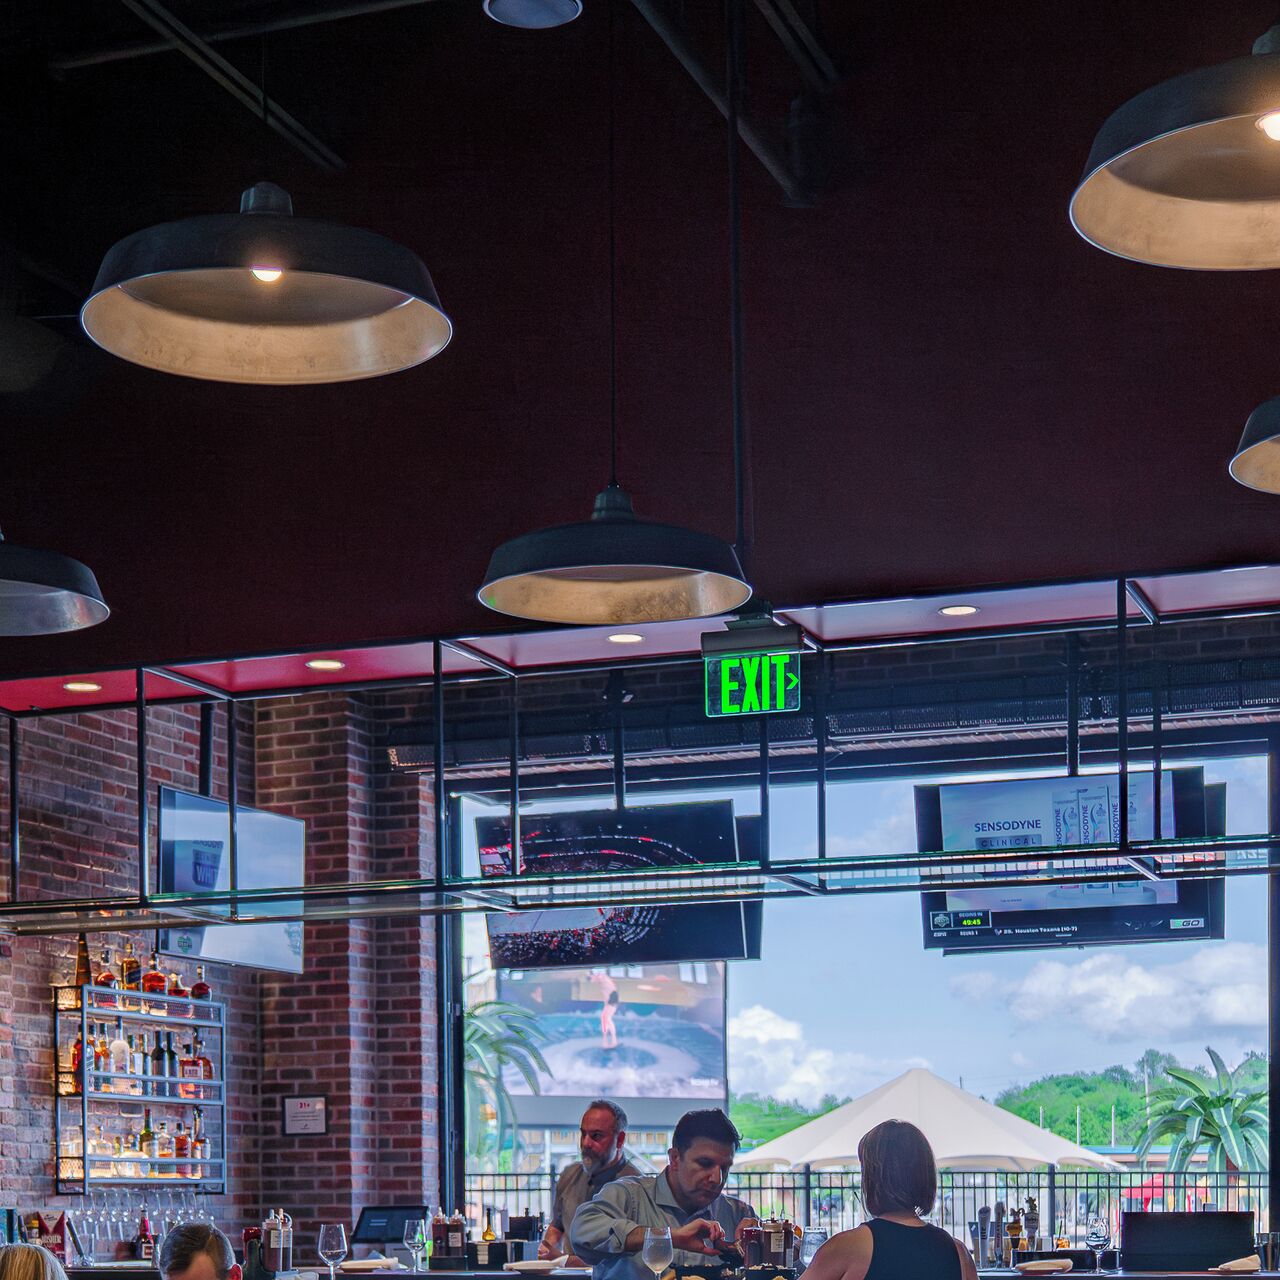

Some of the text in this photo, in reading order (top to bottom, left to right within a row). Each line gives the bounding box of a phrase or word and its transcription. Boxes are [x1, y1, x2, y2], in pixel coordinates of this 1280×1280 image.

[721, 655, 790, 713] EXIT
[974, 819, 1042, 833] SENSODYNE
[981, 837, 1037, 848] CLINICAL
